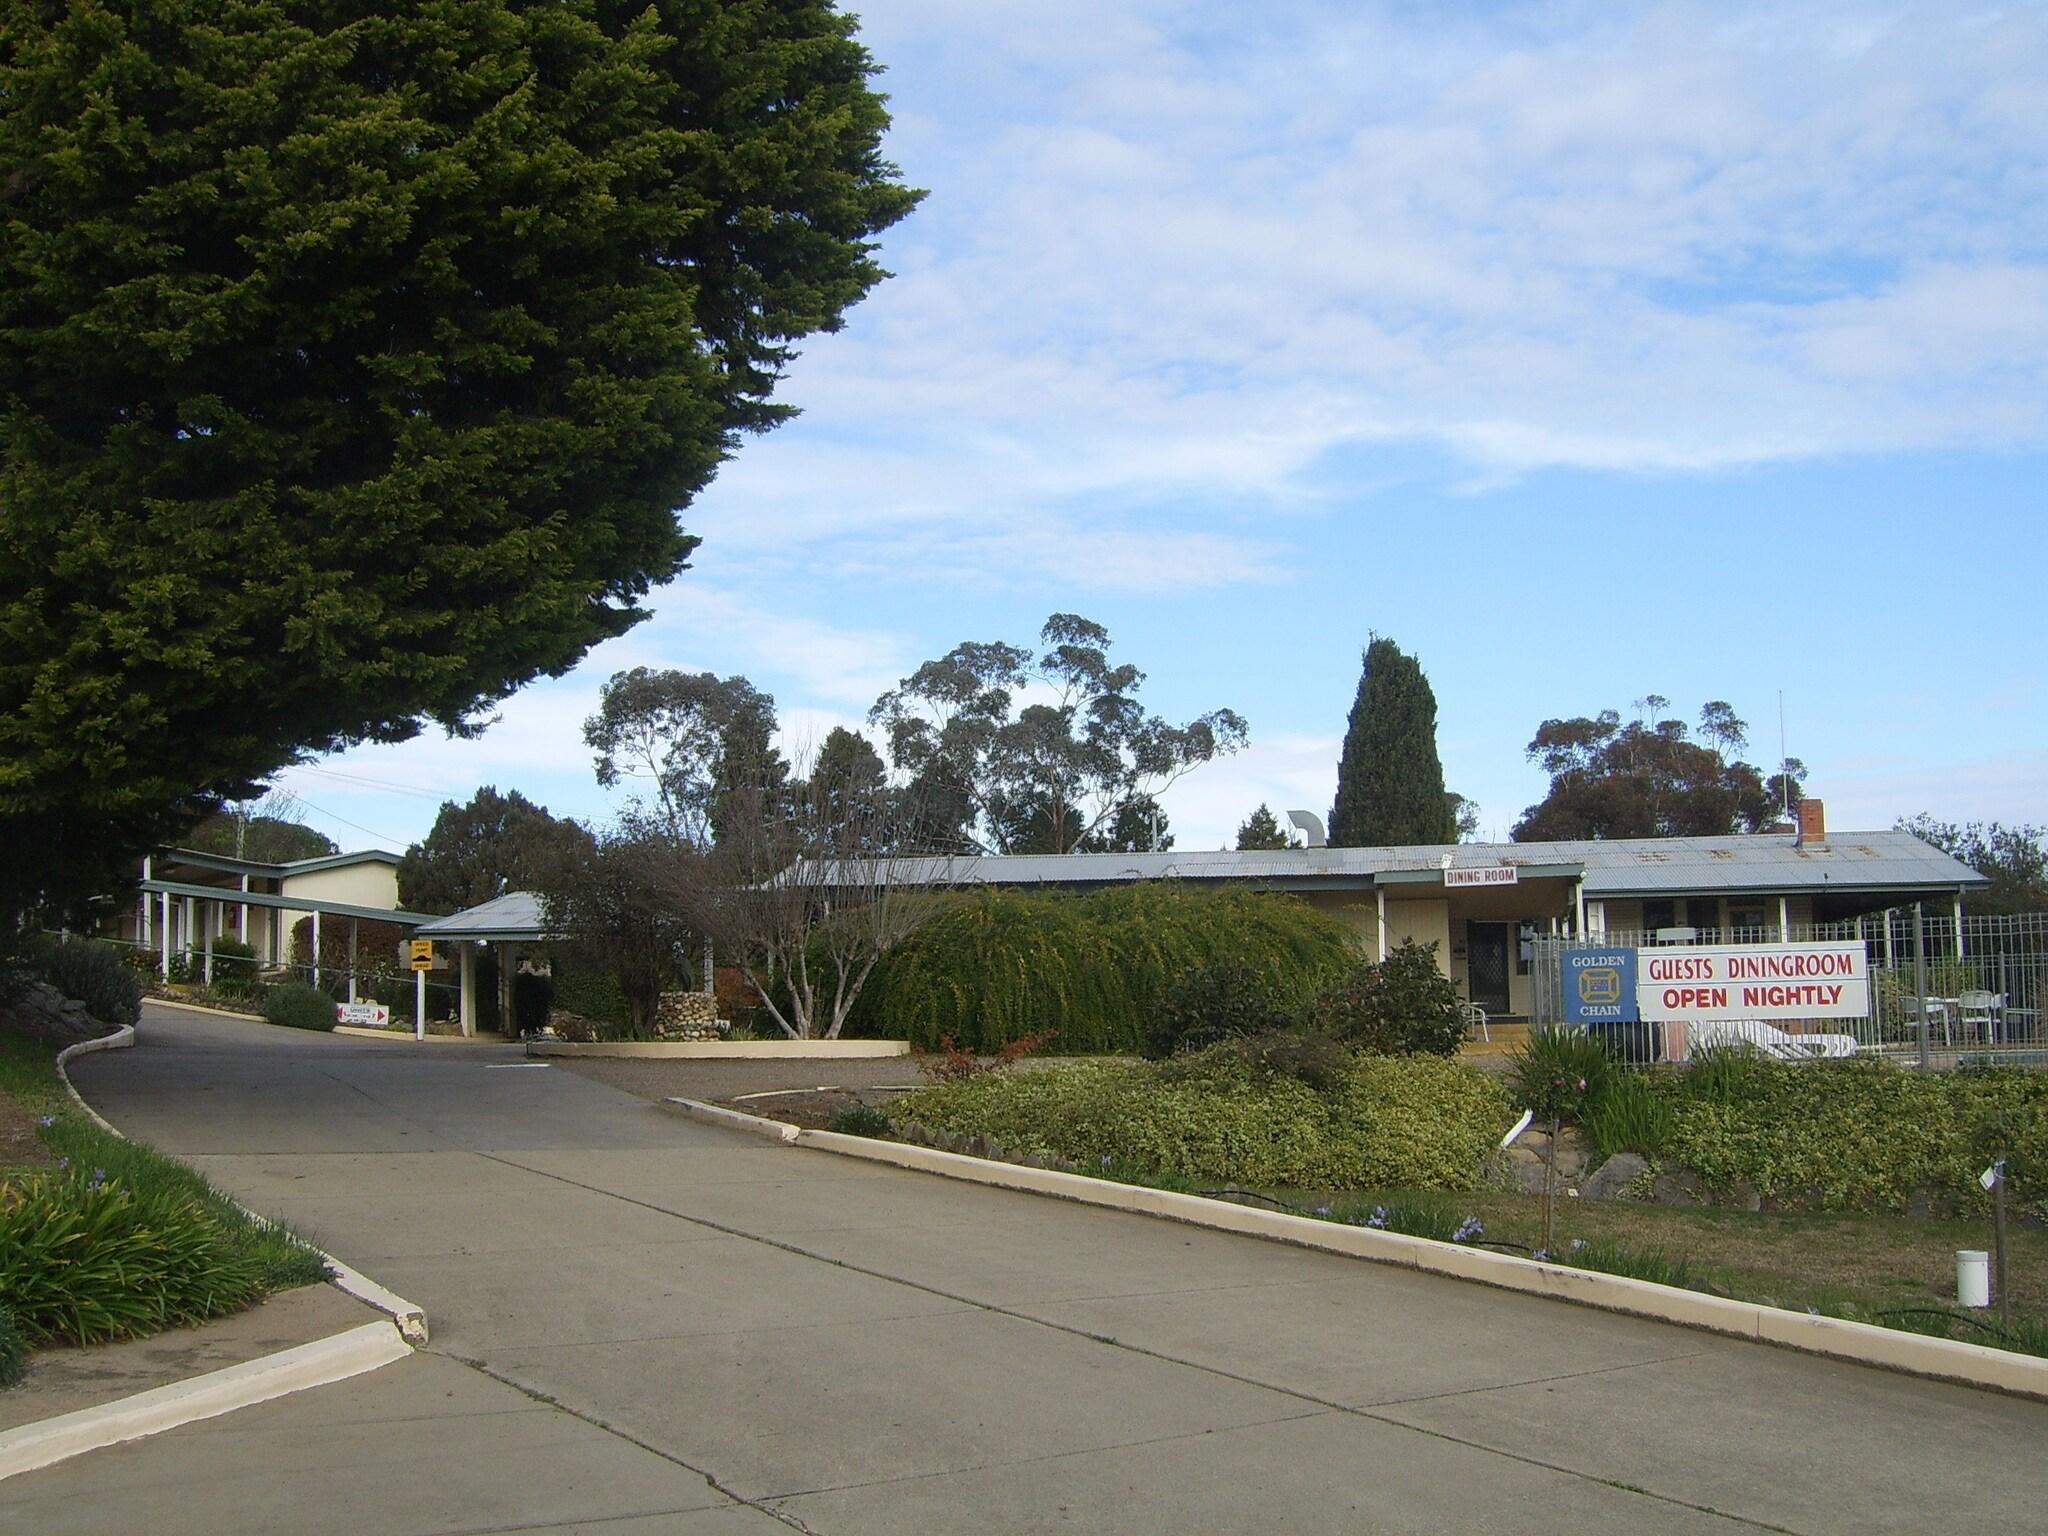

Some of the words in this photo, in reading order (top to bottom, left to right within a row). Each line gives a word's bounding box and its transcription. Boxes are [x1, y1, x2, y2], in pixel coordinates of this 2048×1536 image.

[1447, 870, 1480, 884] DINING
[1485, 869, 1514, 882] ROOM
[1572, 956, 1625, 967] GOLDEN
[1649, 957, 1714, 980] GUESTS
[1727, 953, 1853, 979] DININGROOM
[1662, 988, 1728, 1009] OPEN
[1743, 985, 1843, 1007] NIGHTLY
[1580, 1005, 1621, 1017] CHAIN
